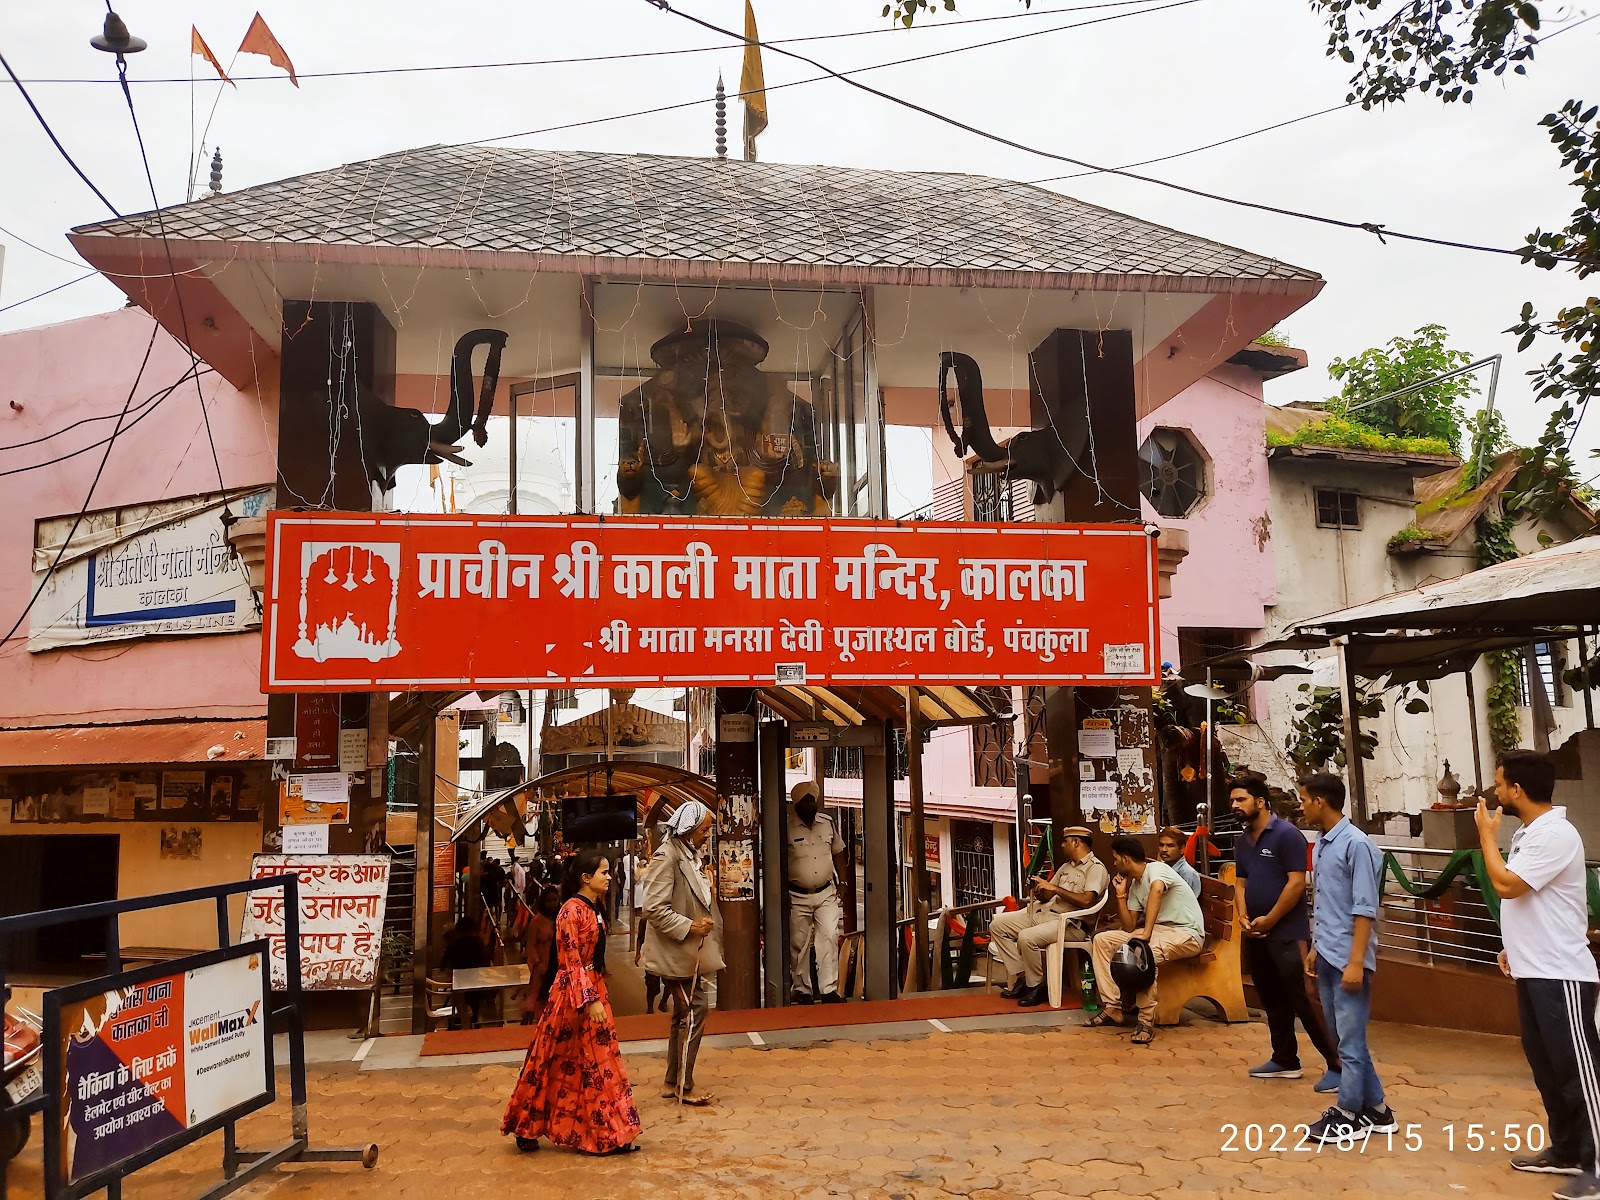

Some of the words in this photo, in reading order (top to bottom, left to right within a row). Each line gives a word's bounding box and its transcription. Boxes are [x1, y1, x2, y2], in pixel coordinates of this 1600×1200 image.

[161, 546, 193, 579] माता
[417, 540, 544, 598] प्राचीन
[552, 541, 604, 598] श्री
[611, 542, 718, 599] काली
[732, 556, 820, 599] माता
[833, 544, 951, 611] मन्दिर,
[958, 558, 1088, 602] कालका
[139, 586, 188, 606] कालका
[118, 619, 192, 636] TRAVELS
[196, 615, 236, 629] LINE
[598, 619, 632, 653] श्री
[638, 627, 697, 653] माता
[703, 627, 774, 654] मनसा
[779, 619, 824, 653] देवी
[833, 626, 937, 662] पूजास्थल
[944, 619, 995, 659] बोर्ड,
[1003, 619, 1090, 663] पंचकुला
[301, 895, 382, 921] उतारना
[299, 932, 348, 954] पाप
[352, 922, 376, 959] है
[111, 1014, 152, 1041] कालका
[154, 1004, 169, 1027] जी
[204, 1038, 220, 1050] Cement
[116, 1062, 130, 1086] के
[131, 1056, 154, 1081] लिए
[155, 1044, 178, 1072] रुकें
[84, 1099, 112, 1122] हेलमेट
[113, 1091, 126, 1110] एवं
[126, 1086, 143, 1104] सीट
[161, 1076, 172, 1090] का
[93, 1116, 124, 1140] उपयोग
[125, 1105, 151, 1127] अवश्य
[151, 1095, 166, 1115] करें
